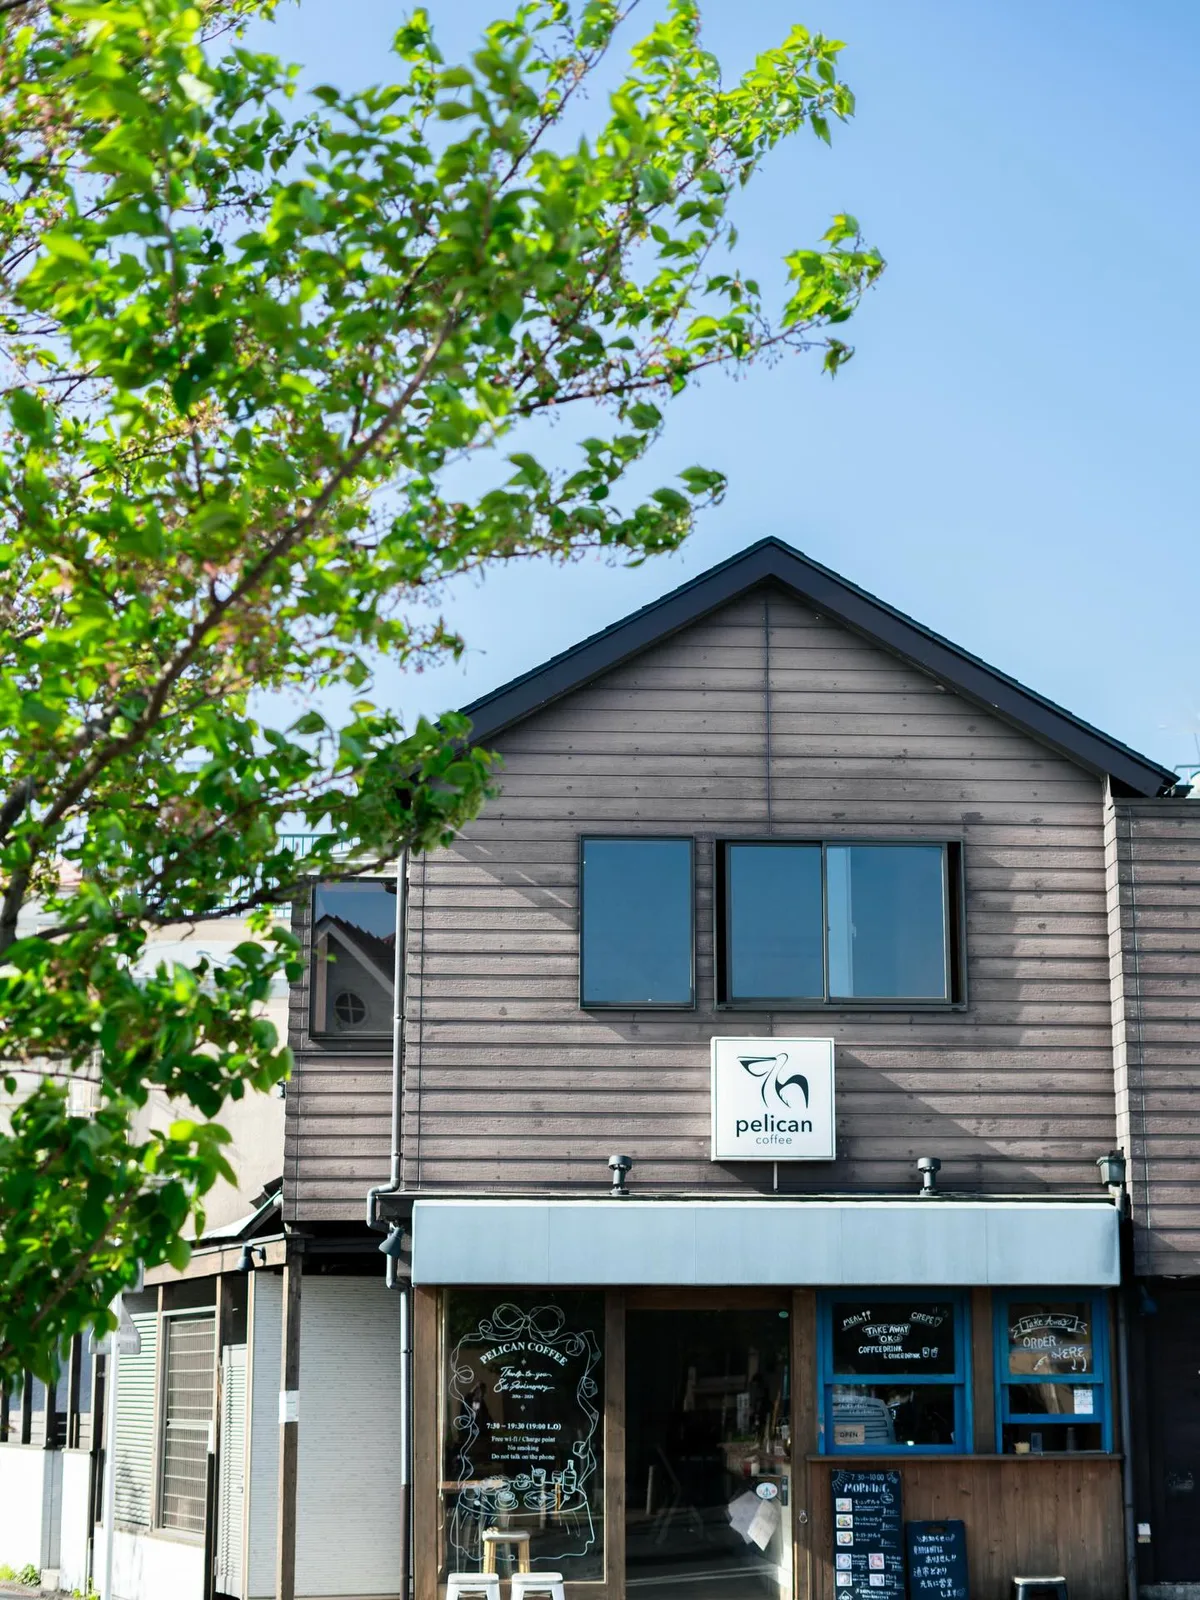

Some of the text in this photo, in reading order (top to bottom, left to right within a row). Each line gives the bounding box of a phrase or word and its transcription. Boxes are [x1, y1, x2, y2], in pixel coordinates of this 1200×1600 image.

[735, 1113, 813, 1138] pelican
[756, 1134, 793, 1145] coffee
[842, 1315, 863, 1327] MEAL
[911, 1311, 935, 1325] CREPE
[1021, 1315, 1072, 1328] Take Away
[865, 1325, 909, 1335] TAKE AWAY
[880, 1335, 894, 1343] OK
[1022, 1335, 1057, 1349] ORDER
[480, 1341, 568, 1367] PELICAN COFFEE
[1051, 1346, 1085, 1359] HERE
[486, 1422, 500, 1430] 7:30
[507, 1422, 525, 1430] 19:30
[843, 1482, 890, 1493] MORNING
